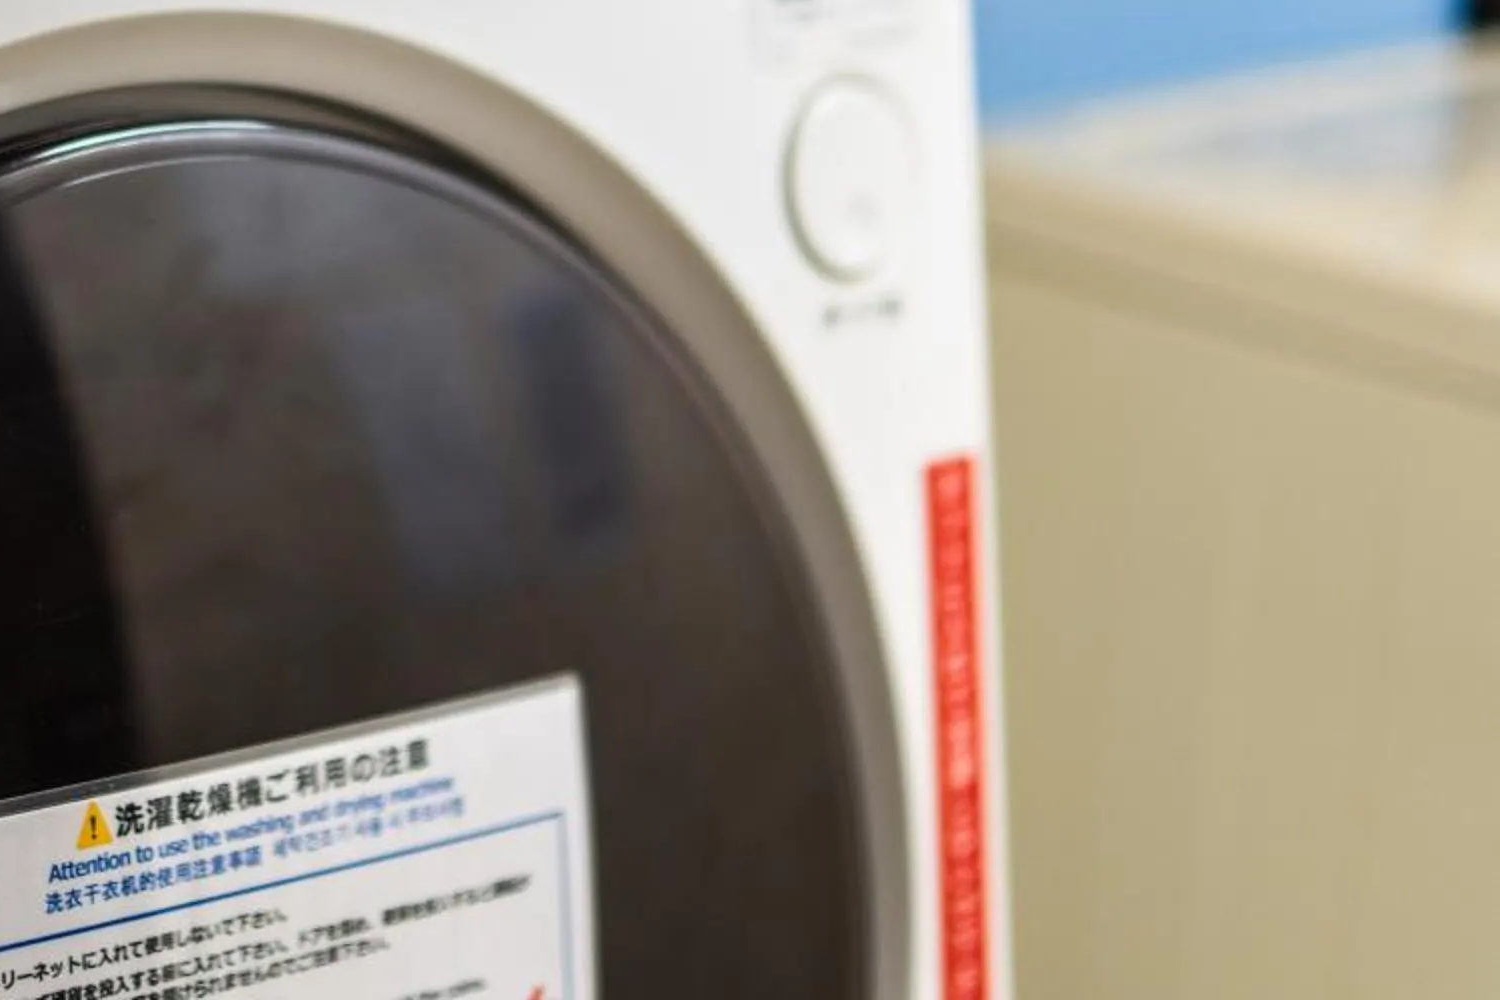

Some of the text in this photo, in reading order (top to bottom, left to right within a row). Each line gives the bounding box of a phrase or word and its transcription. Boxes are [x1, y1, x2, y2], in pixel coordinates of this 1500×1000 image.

[115, 738, 429, 838] 洗濯乾燥機ご利用の注意
[48, 850, 132, 884] Attention
[136, 846, 154, 864] to
[158, 839, 189, 858] use
[192, 830, 222, 851] the
[224, 814, 295, 843] washing
